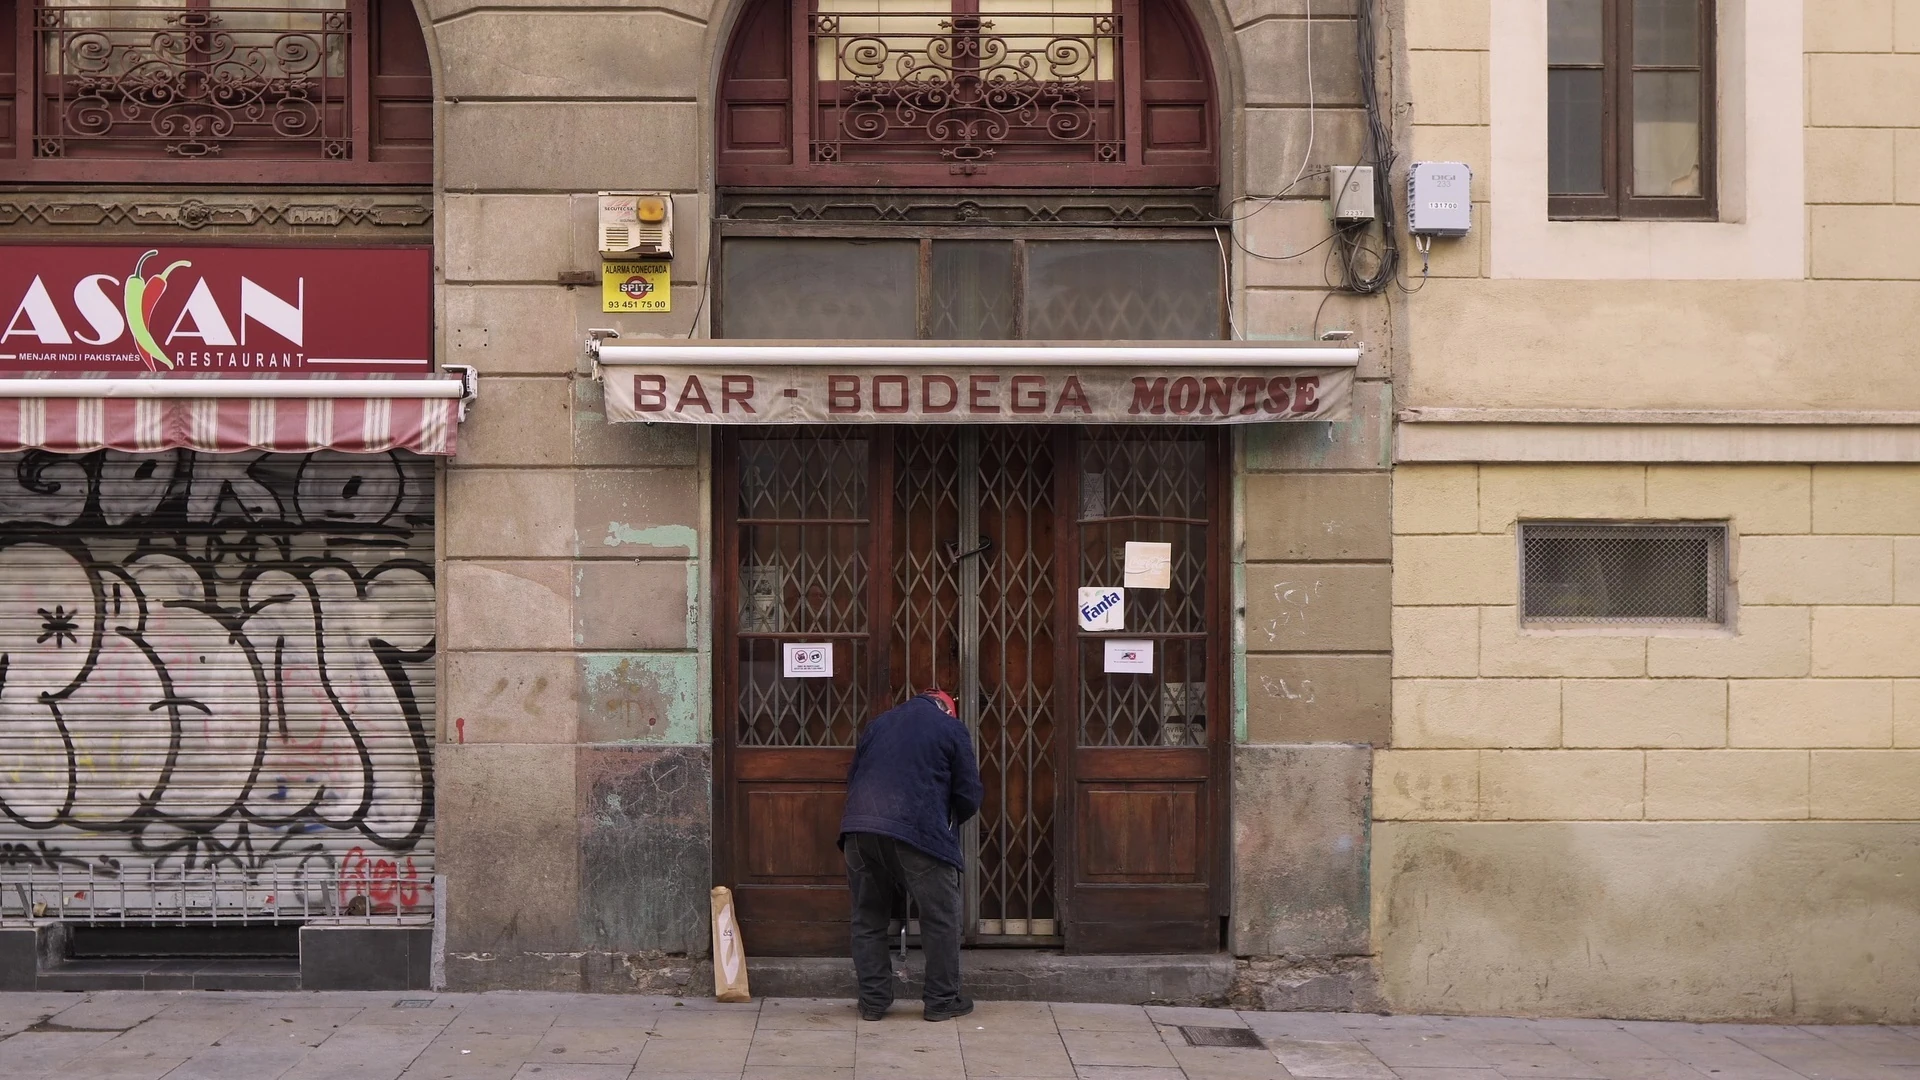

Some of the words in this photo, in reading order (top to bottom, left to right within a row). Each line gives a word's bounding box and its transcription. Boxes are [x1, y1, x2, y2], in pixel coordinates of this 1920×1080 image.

[605, 265, 630, 274] ALARMA
[631, 265, 667, 274] CONECTADA
[620, 283, 653, 292] SPITZ
[19, 353, 57, 361] MENJAR
[84, 353, 140, 362] PAKISTANÈS
[176, 351, 304, 367] RESTAURANT
[633, 374, 756, 414] BAR
[828, 374, 1092, 414] BODEGA
[1127, 375, 1320, 415] MONTSE
[1081, 592, 1120, 622] Fanta
